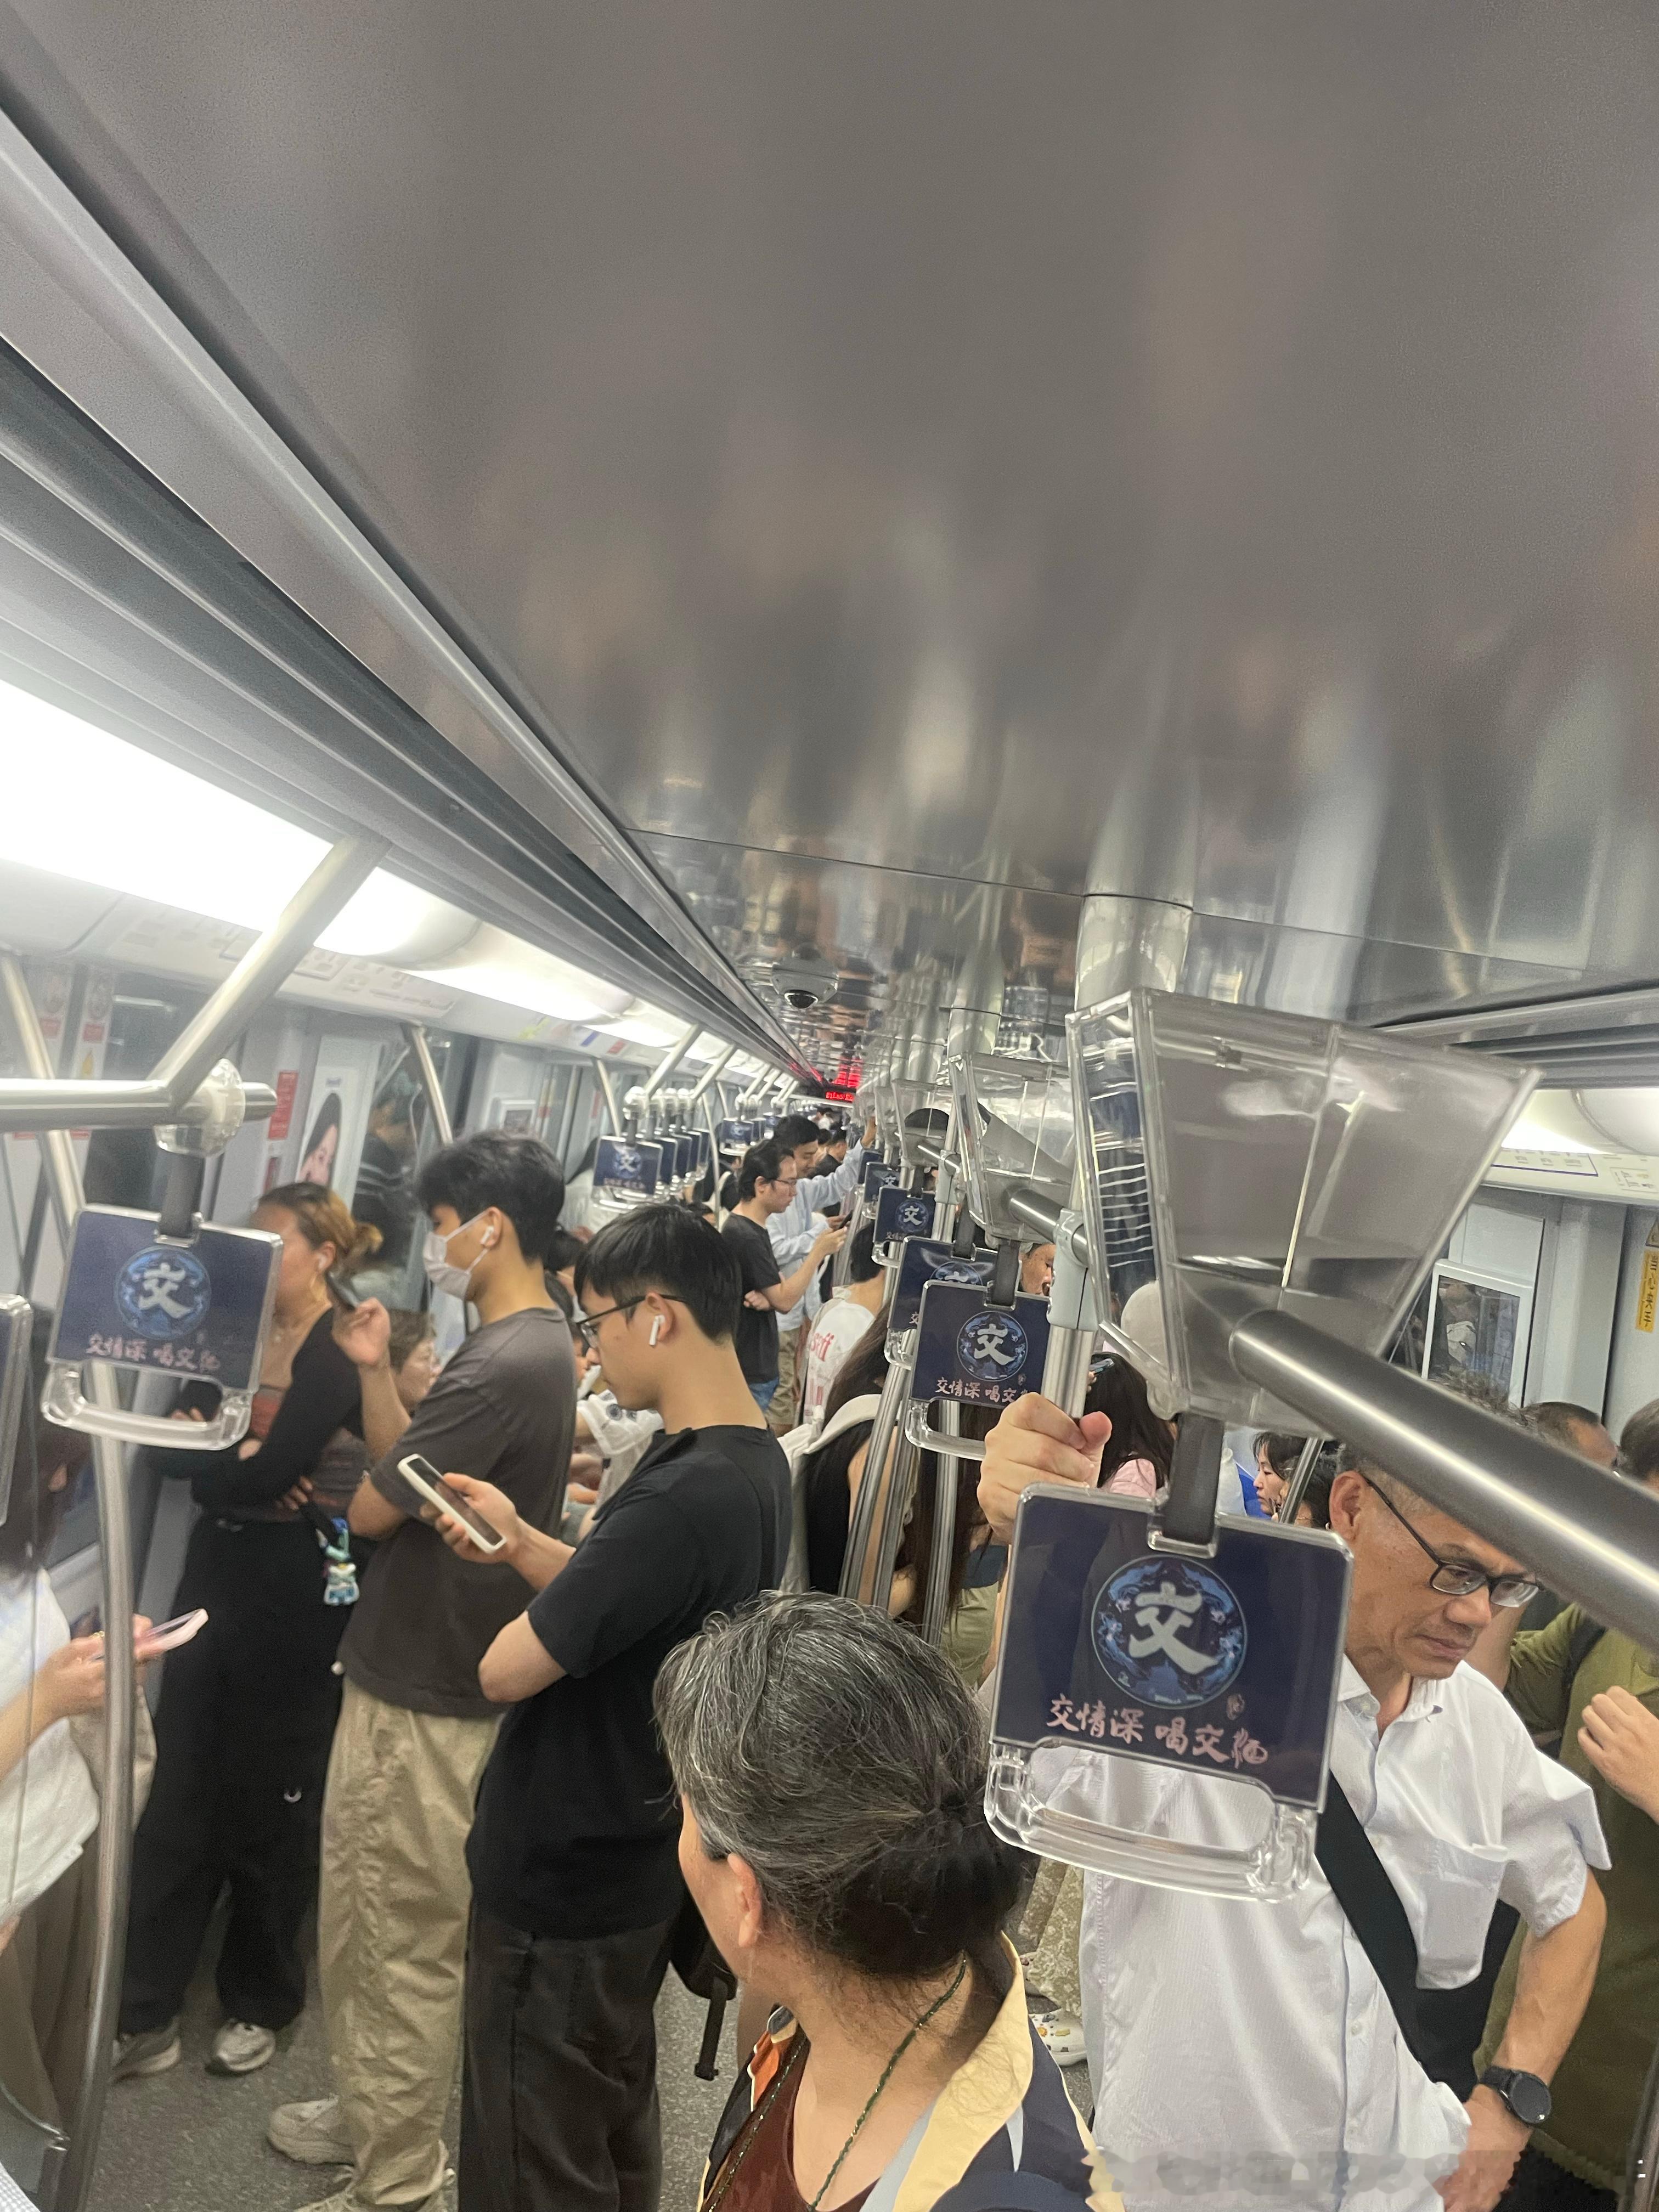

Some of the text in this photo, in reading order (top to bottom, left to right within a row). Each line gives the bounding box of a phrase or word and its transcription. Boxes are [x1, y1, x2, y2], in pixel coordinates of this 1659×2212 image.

[903, 1205, 923, 1226] 交
[138, 1262, 192, 1319] 交
[974, 1323, 1016, 1366] 交
[935, 1376, 1028, 1403] 交情深 喝交
[1128, 1581, 1219, 1675] 交
[1046, 1692, 1144, 1744] 交情深
